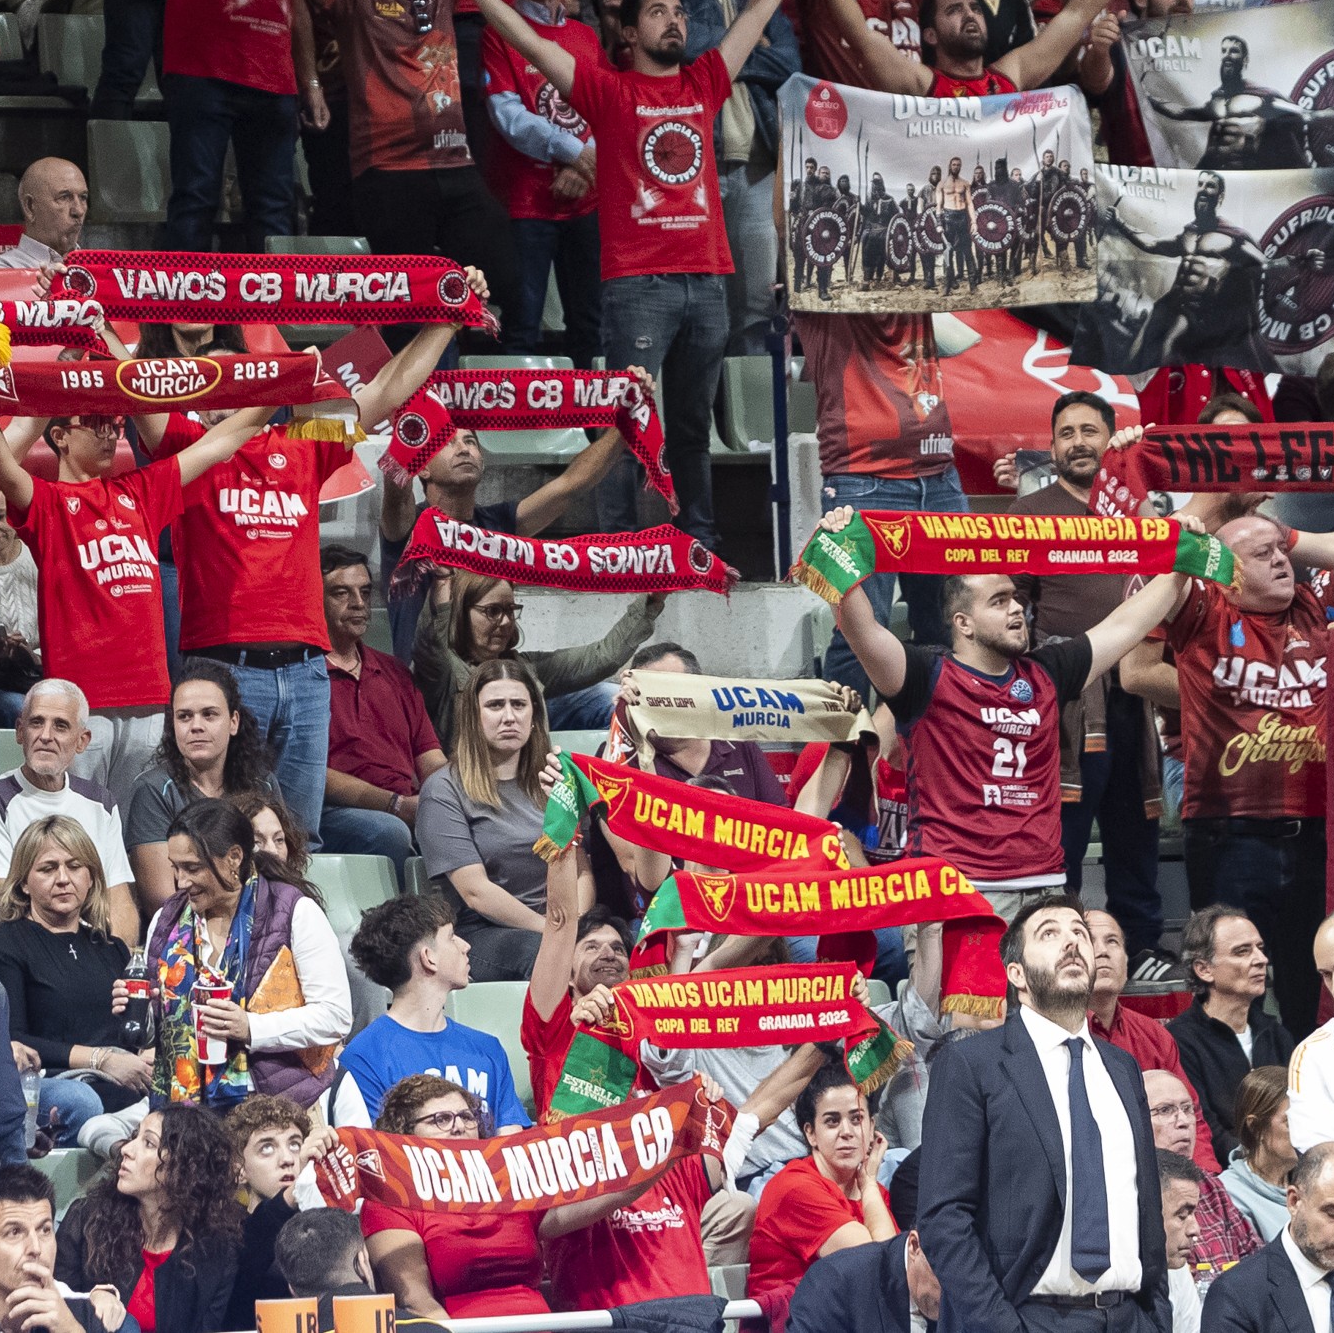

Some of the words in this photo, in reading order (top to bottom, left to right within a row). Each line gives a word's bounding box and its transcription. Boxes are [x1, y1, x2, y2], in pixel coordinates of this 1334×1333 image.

[113, 267, 227, 303] VAMOS
[239, 271, 282, 303] CB
[293, 271, 412, 305] MURCIA
[61, 369, 105, 389] 1985
[136, 358, 200, 378] UCAM
[234, 360, 279, 381] 2023
[132, 372, 207, 397] MURCIA
[916, 515, 992, 542] VAMOS
[994, 515, 1056, 542] UCAM
[1058, 517, 1137, 542] MURCIA
[1140, 517, 1170, 542] CB
[77, 533, 159, 571] UCAM
[944, 548, 977, 563] COPA
[980, 548, 1003, 563] DEL
[1007, 548, 1030, 564] REY
[1047, 549, 1104, 565] GRANADA
[1108, 549, 1139, 564] 2022
[95, 560, 154, 585] MURCIA
[712, 686, 805, 714] UCAM
[732, 709, 791, 729] MURCIA
[980, 707, 1042, 727] UCAM
[991, 722, 1034, 737] MURCIA
[992, 738, 1027, 778] 21
[634, 790, 707, 838] UCAM
[713, 806, 811, 861] MURCIA
[746, 873, 822, 915] UCAM
[829, 866, 932, 910] MURCIA
[408, 1142, 502, 1204] UCAM
[509, 1122, 626, 1201] MURCIA
[630, 1105, 674, 1167] CB
